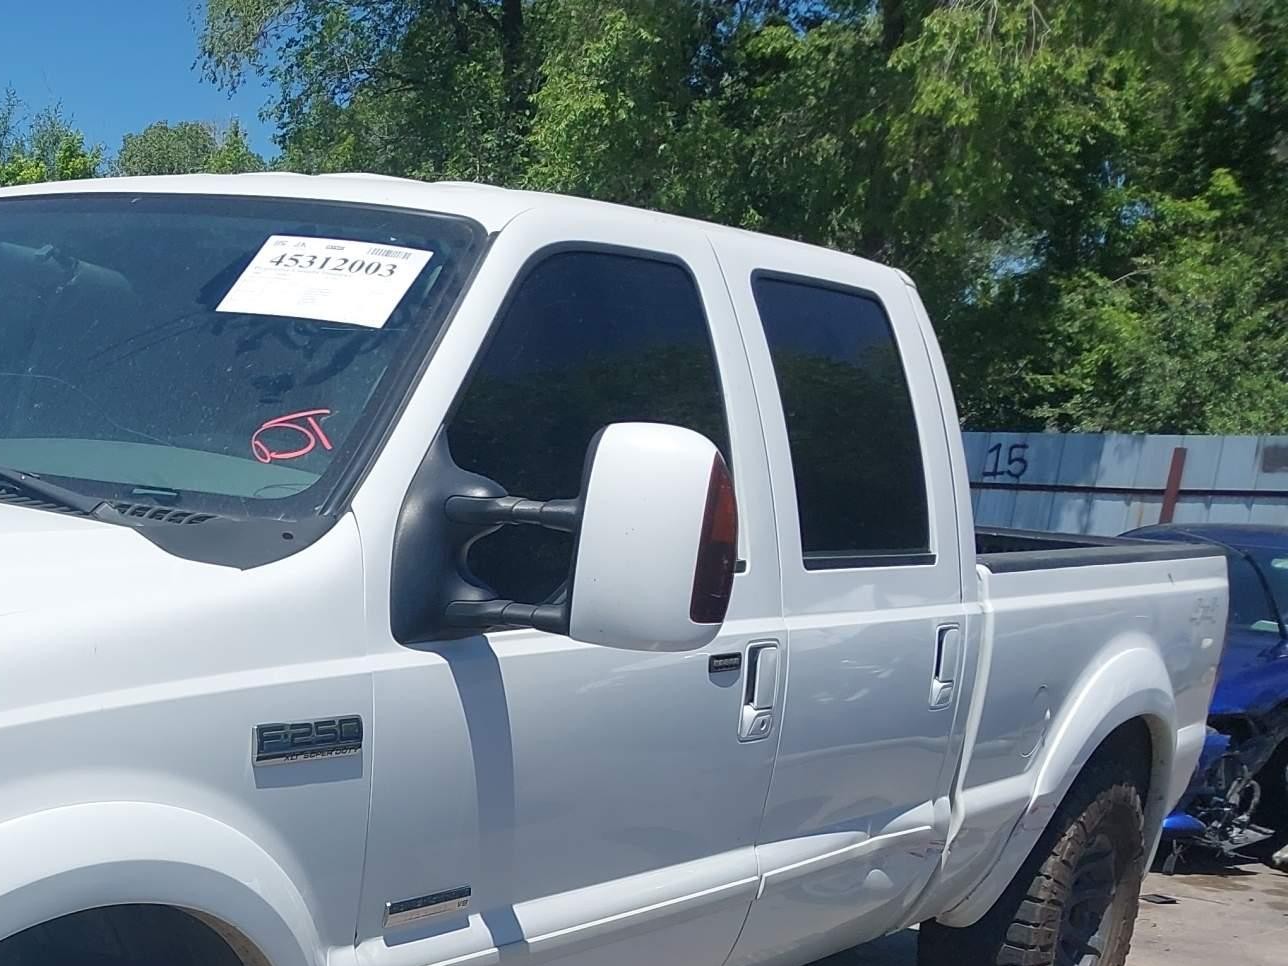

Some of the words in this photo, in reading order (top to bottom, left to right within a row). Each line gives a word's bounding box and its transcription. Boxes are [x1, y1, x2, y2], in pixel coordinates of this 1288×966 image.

[269, 252, 397, 278] 45312003
[982, 443, 1029, 478] 15
[256, 718, 362, 753] F-250
